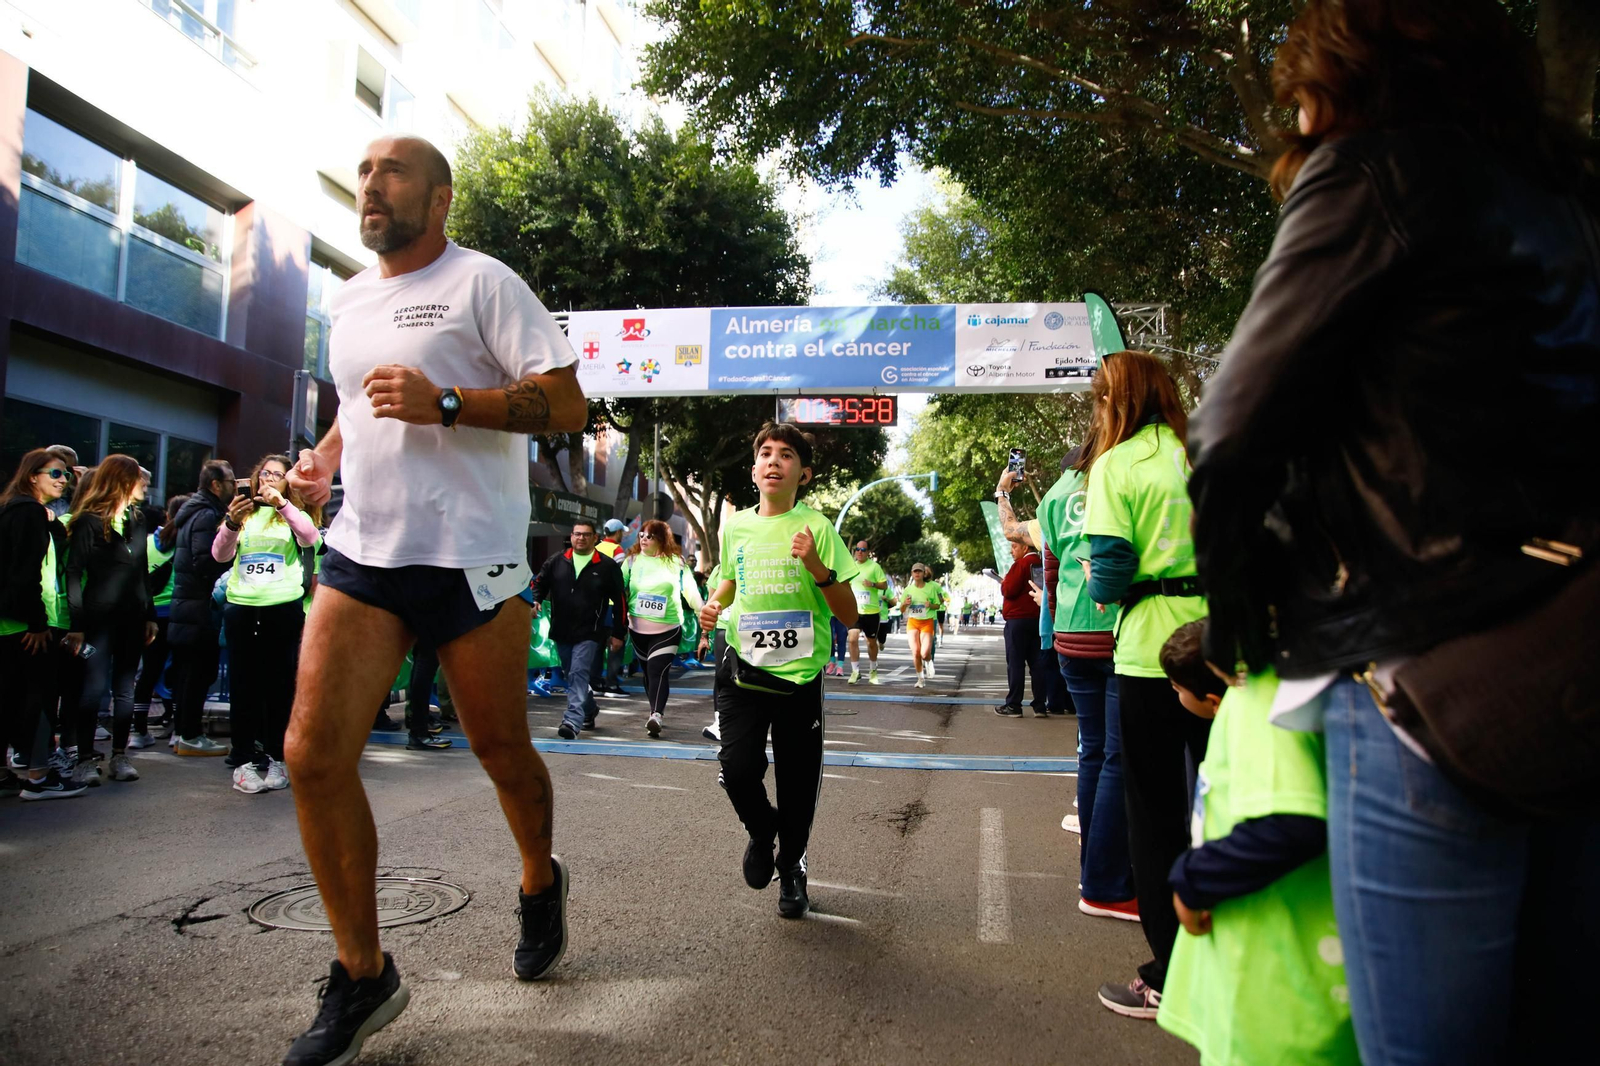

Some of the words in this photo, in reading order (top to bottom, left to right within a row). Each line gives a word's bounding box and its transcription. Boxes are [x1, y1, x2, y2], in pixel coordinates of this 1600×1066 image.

[394, 304, 450, 314] AEROPUERTO
[405, 312, 444, 320] ALMERÍA
[985, 315, 1030, 327] cajamar
[397, 321, 434, 329] BOMBEROS
[725, 316, 812, 335] Almería
[819, 317, 847, 332] en
[855, 313, 940, 331] marcha
[724, 341, 797, 359] contra
[803, 339, 825, 357] el
[831, 338, 912, 357] cáncer
[1028, 340, 1081, 351] Fundación
[1055, 357, 1074, 365] Ejido
[578, 363, 606, 371] LMERÍA
[746, 558, 758, 568] En
[760, 556, 800, 567] marcha
[246, 563, 275, 574] 954
[736, 545, 747, 595] ALMERÍA
[747, 568, 785, 579] contra
[788, 566, 801, 577] el
[748, 581, 802, 595] cáncer
[640, 600, 663, 610] 1068
[752, 630, 798, 650] 238
